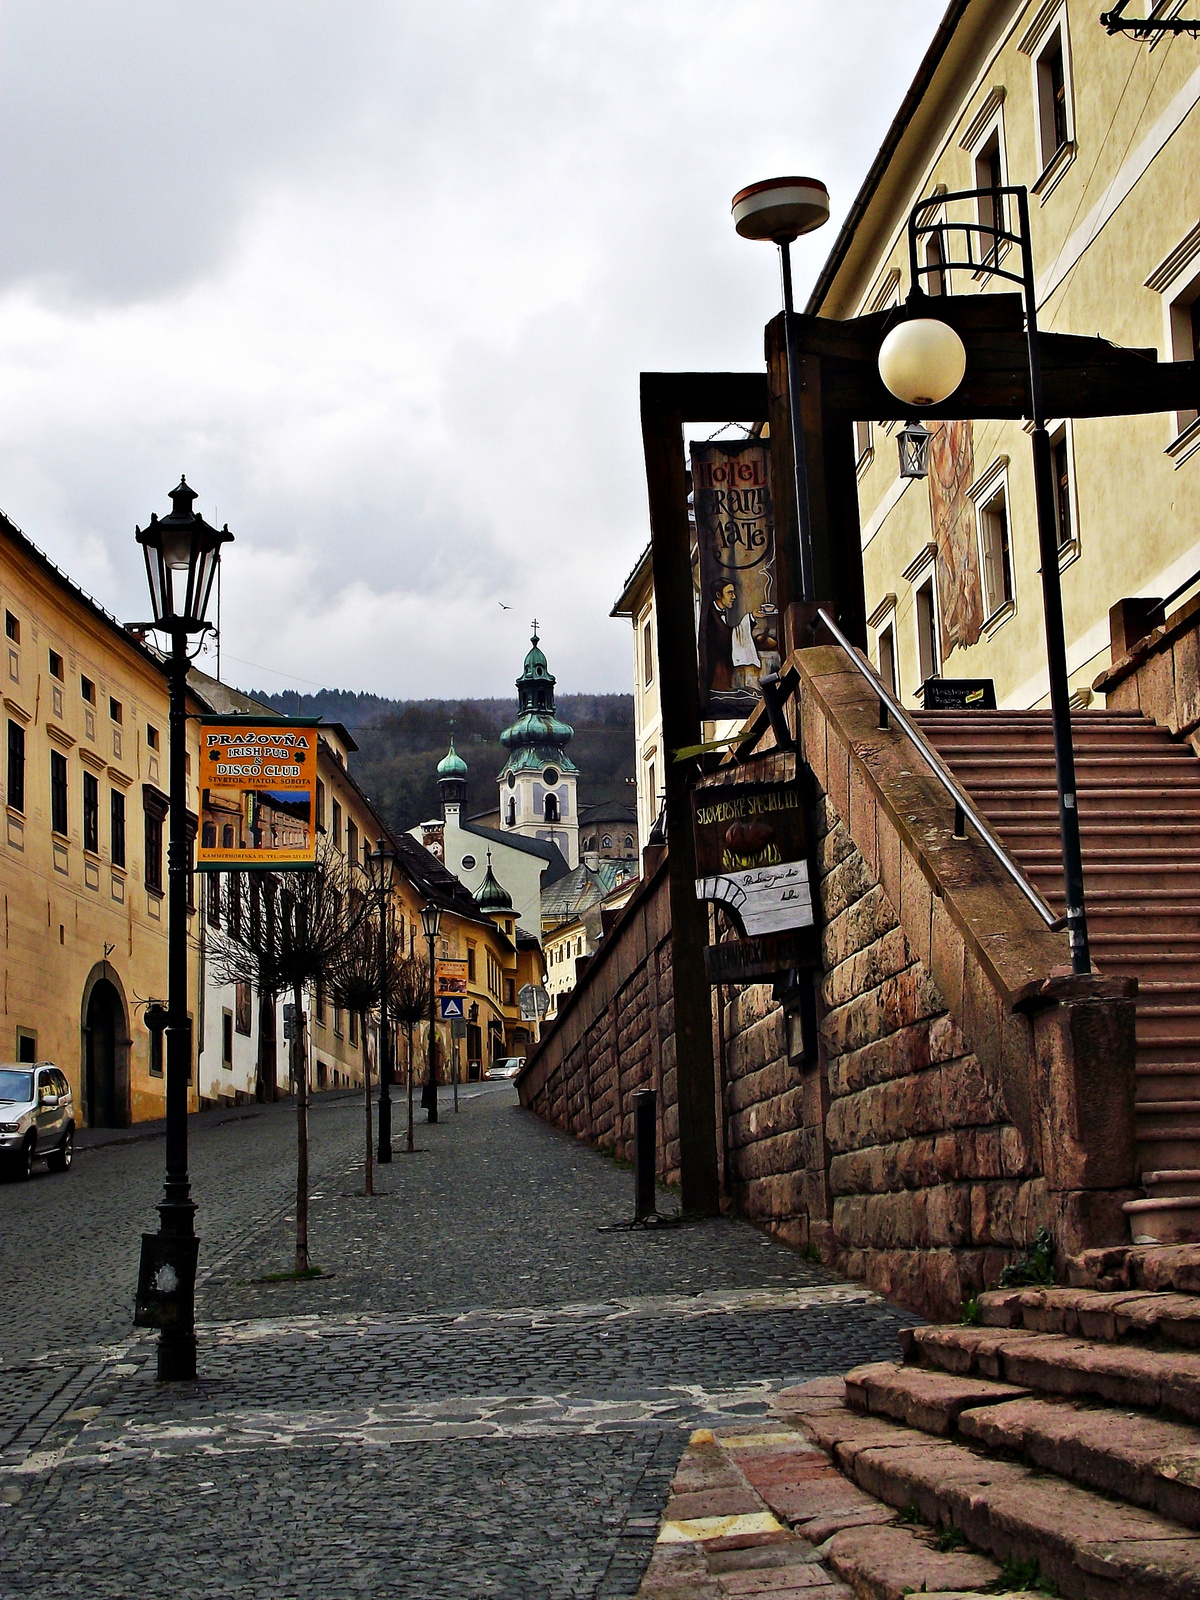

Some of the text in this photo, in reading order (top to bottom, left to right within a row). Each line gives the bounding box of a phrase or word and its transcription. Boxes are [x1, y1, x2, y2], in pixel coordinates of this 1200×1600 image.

[207, 733, 309, 749] PRAŽOVŇA
[227, 747, 289, 759] IRISH PUB
[254, 757, 263, 765] &
[216, 764, 301, 777] DISCO CLUB
